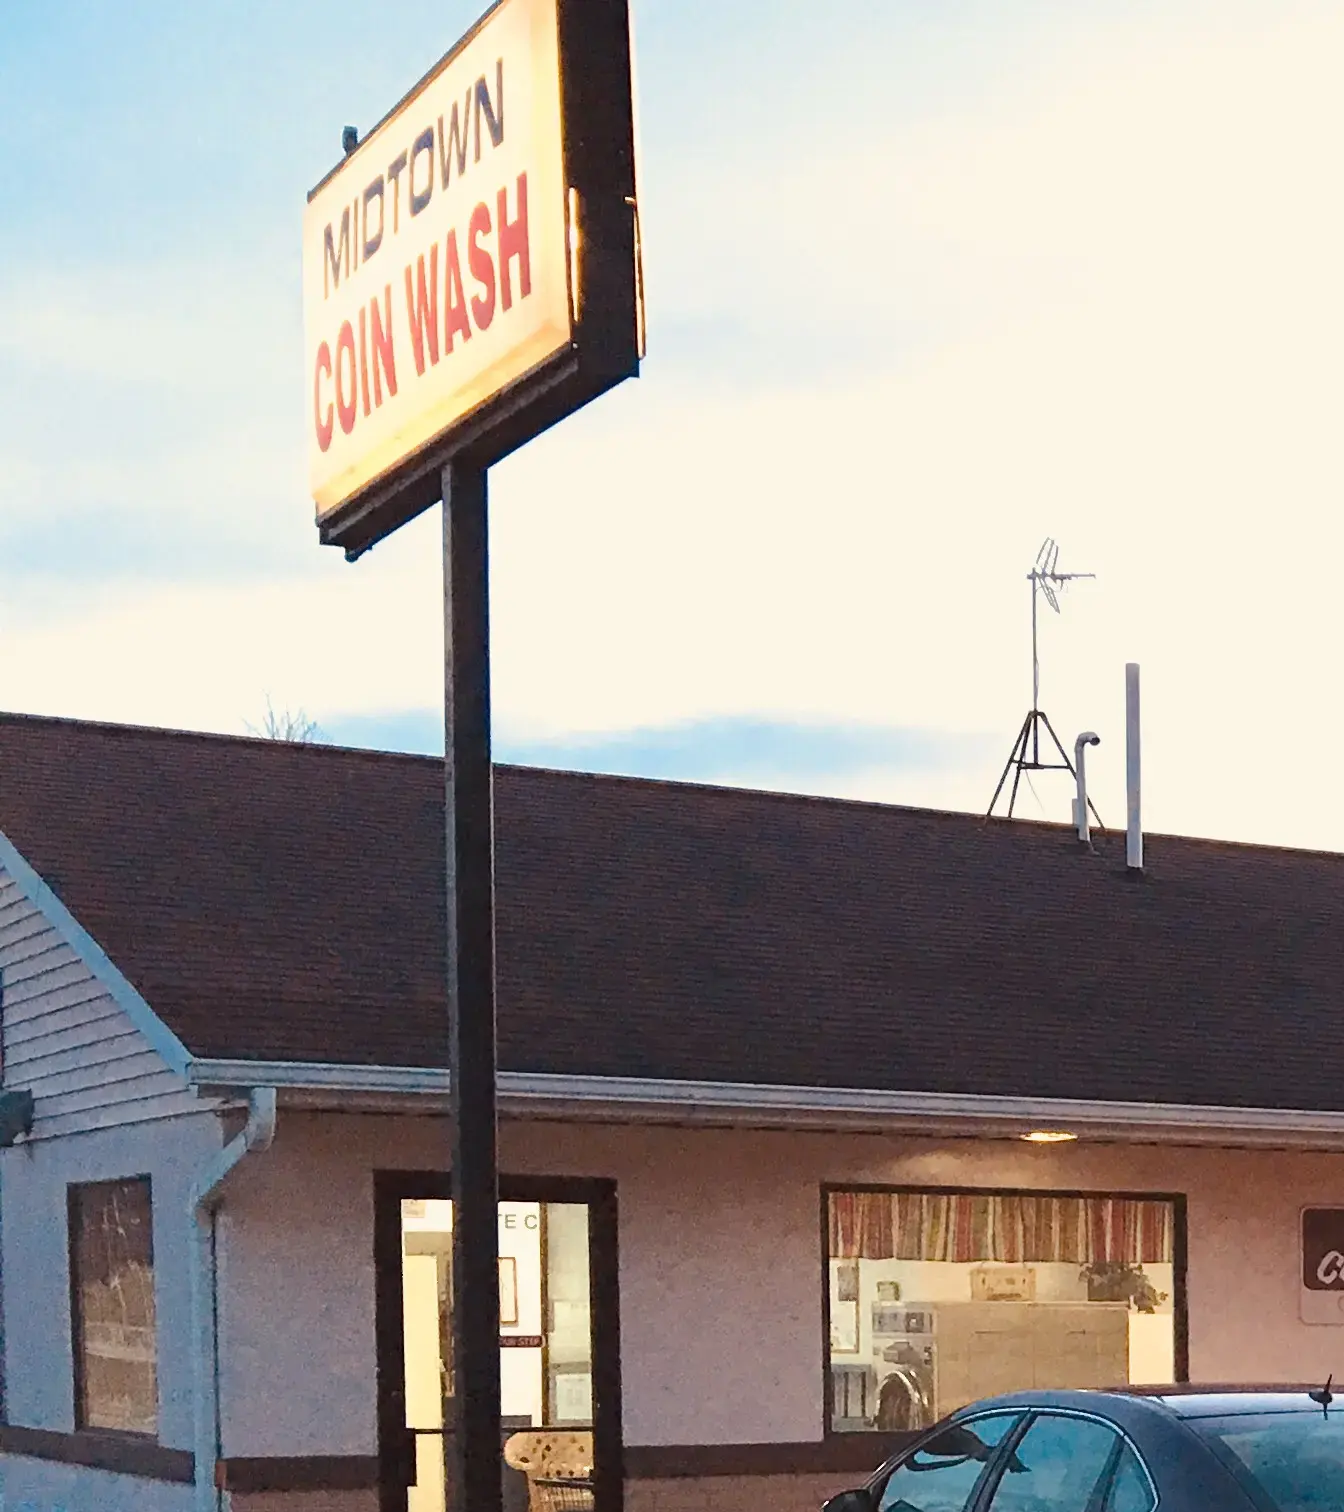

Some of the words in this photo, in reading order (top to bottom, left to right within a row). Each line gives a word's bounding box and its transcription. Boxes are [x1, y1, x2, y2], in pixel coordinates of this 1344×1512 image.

[323, 57, 505, 300] MIDTOWN
[313, 284, 398, 453] COIN
[404, 170, 532, 377] WASH
